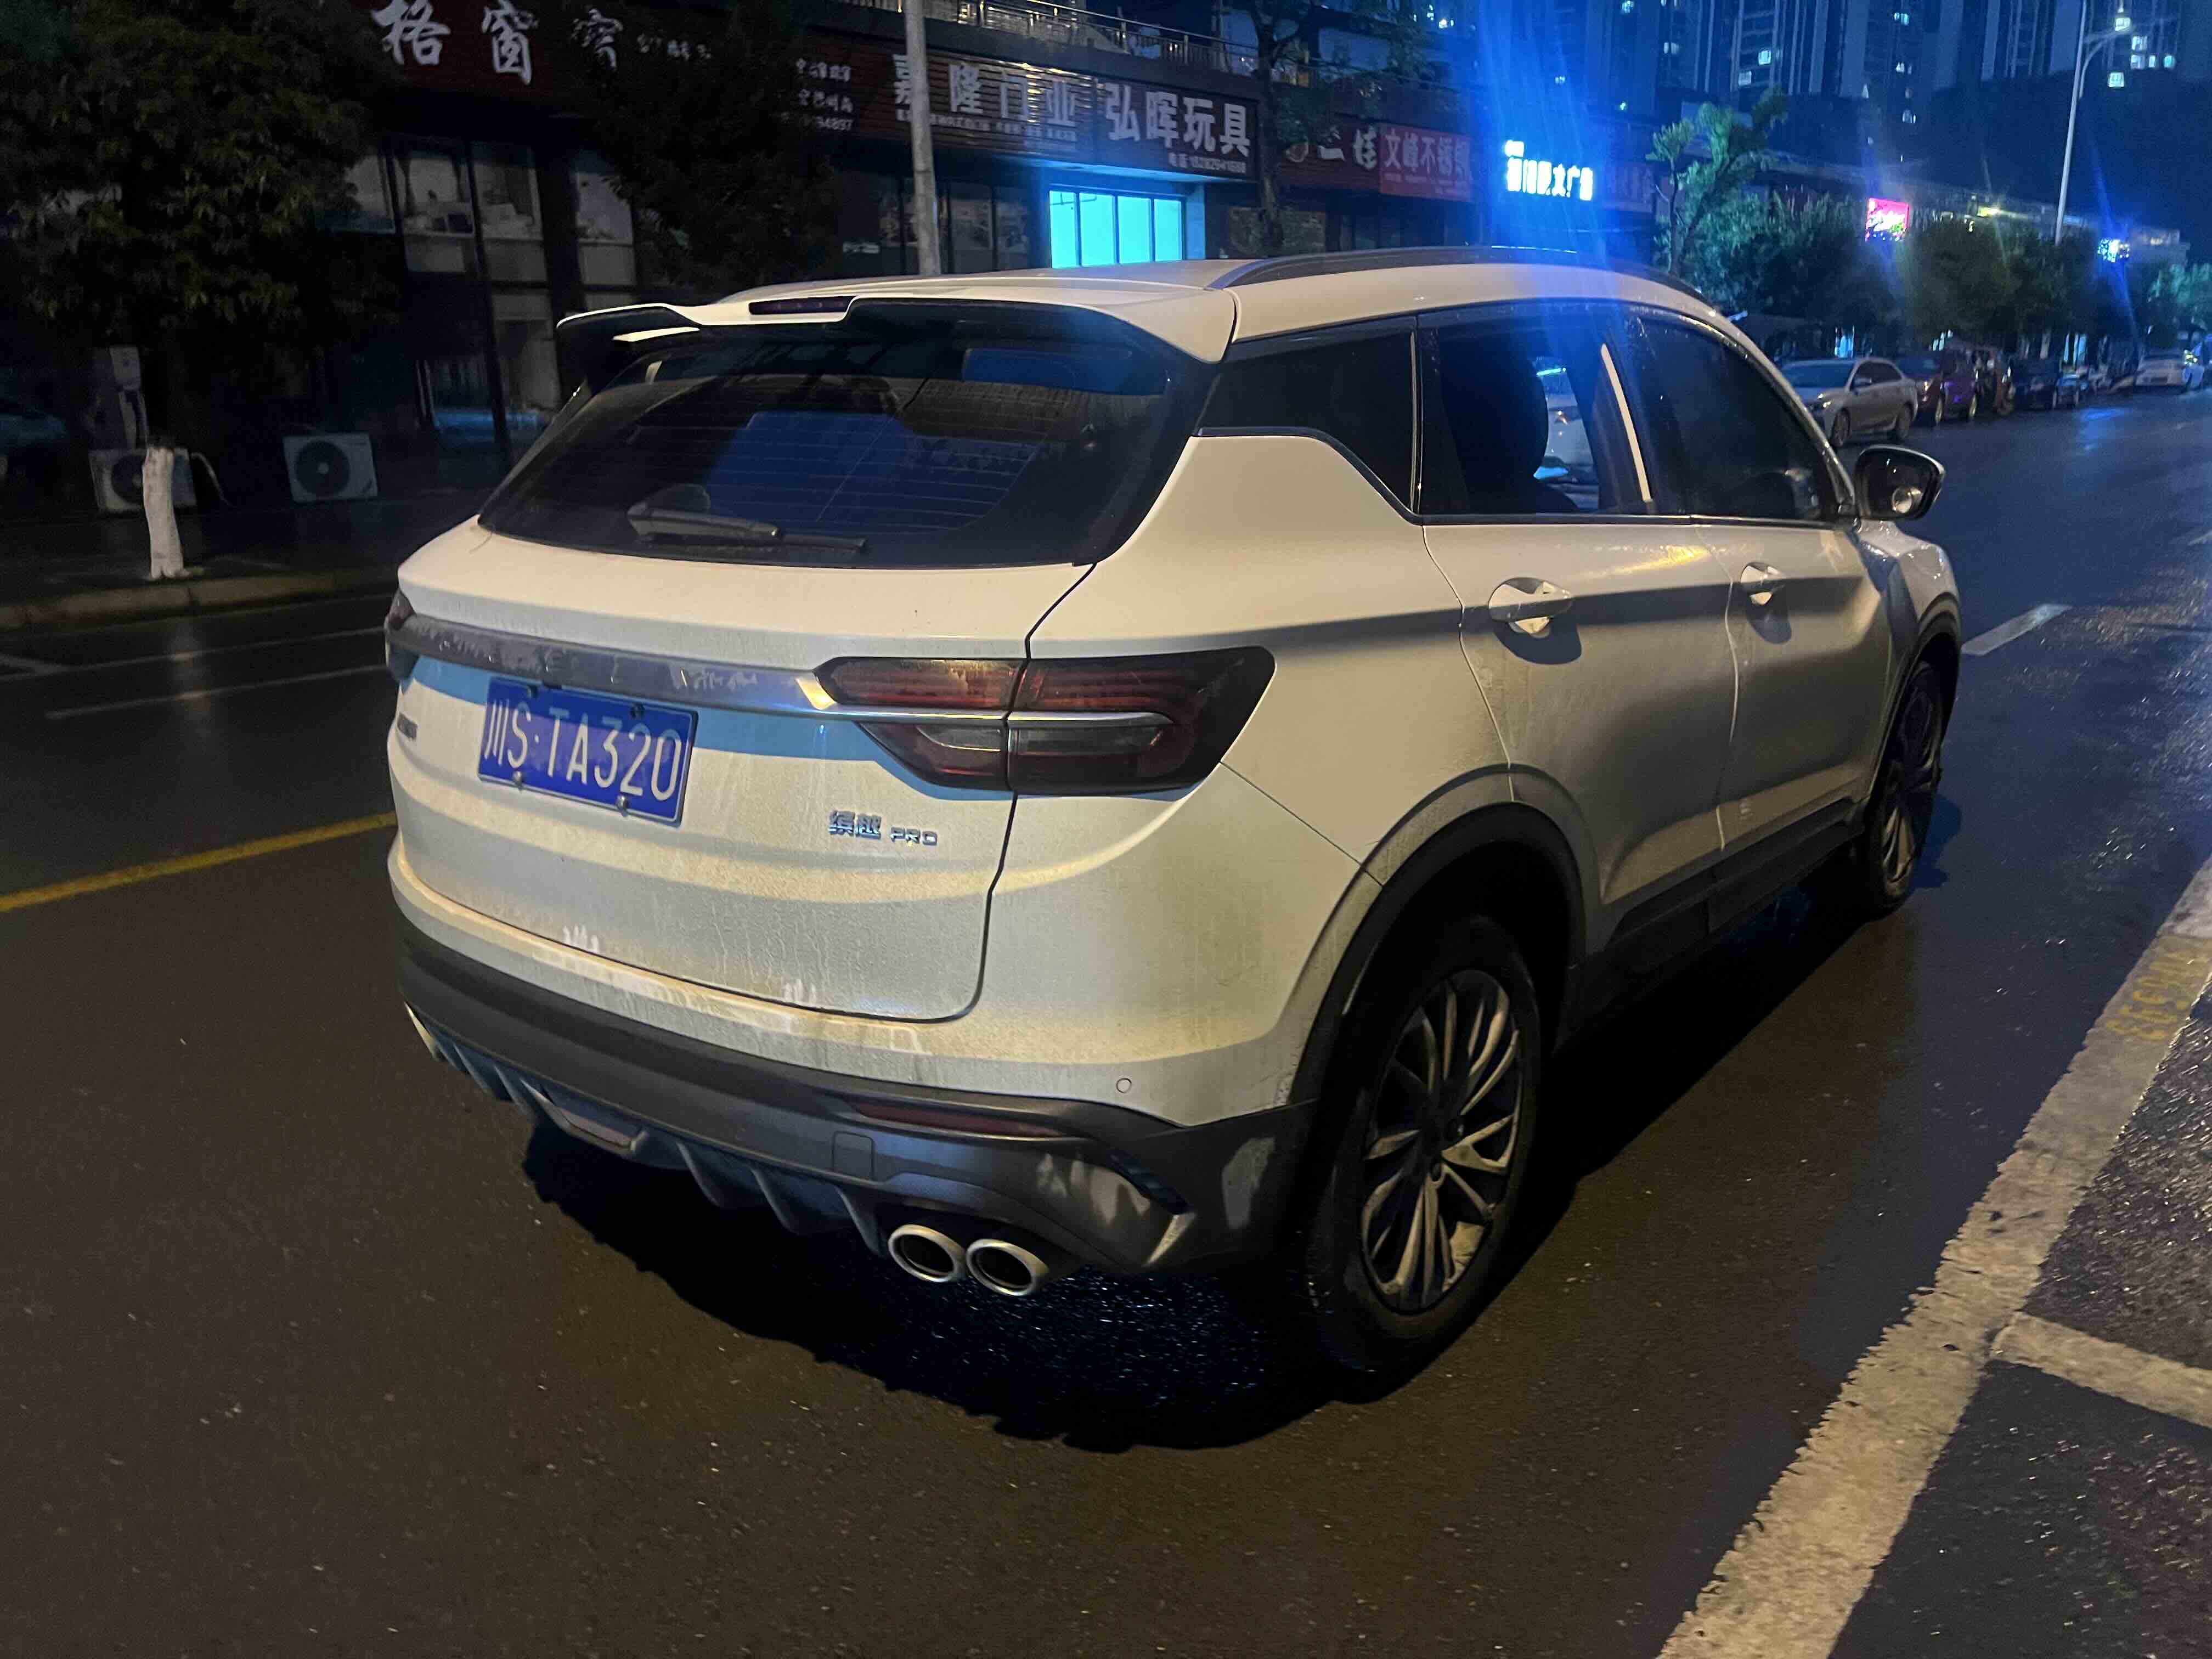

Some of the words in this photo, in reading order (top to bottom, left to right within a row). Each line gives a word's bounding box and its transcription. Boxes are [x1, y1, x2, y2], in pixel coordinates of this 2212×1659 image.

[1105, 82, 1250, 157] 弘晖玩具
[890, 826, 938, 846] PRO
